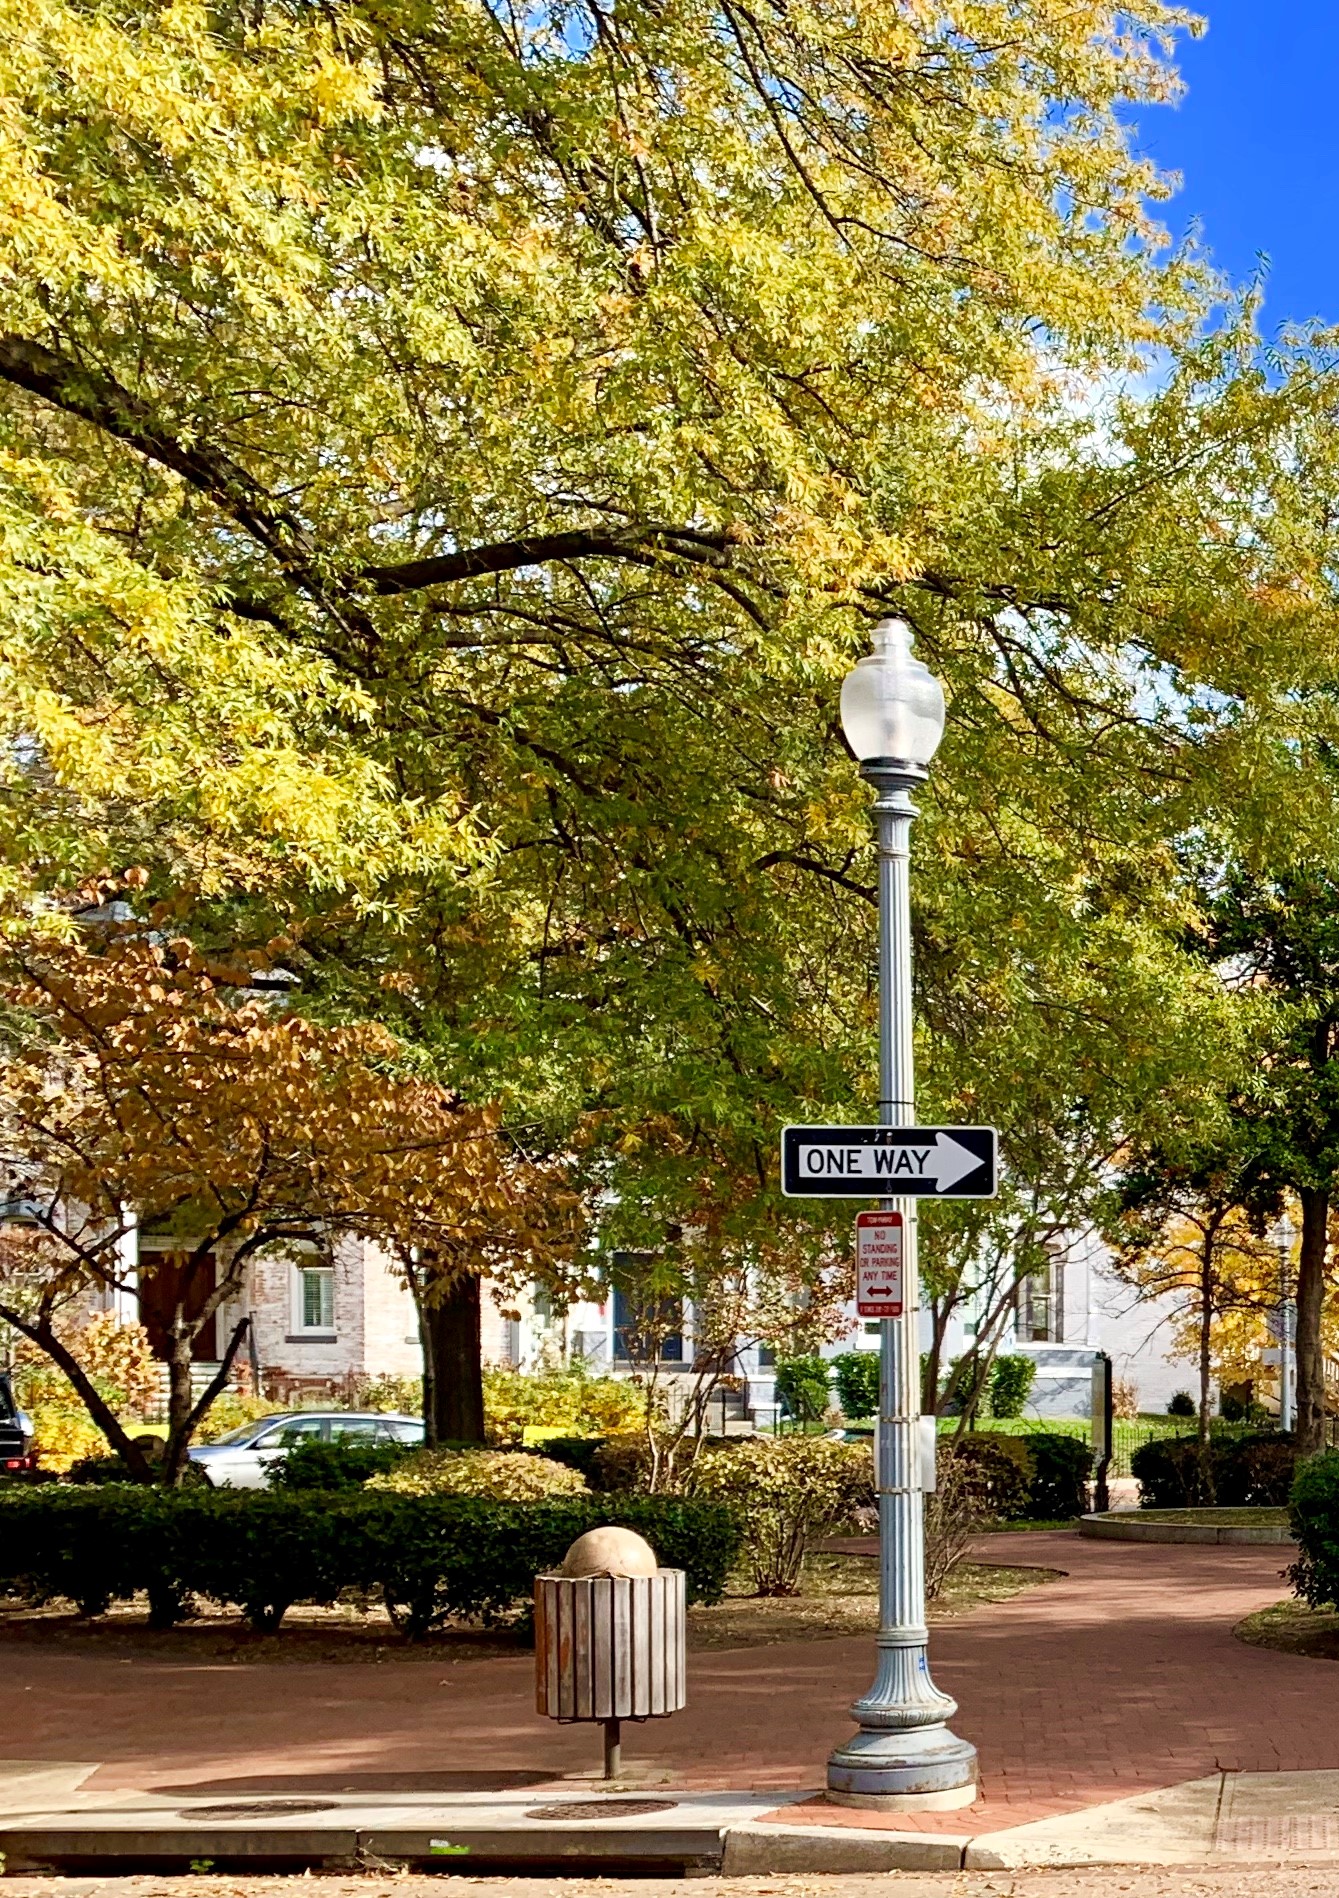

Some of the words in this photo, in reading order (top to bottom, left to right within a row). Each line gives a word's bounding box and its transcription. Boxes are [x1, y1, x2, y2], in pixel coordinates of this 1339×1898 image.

[807, 1149, 862, 1174] ONE
[873, 1149, 931, 1174] WAY
[874, 1230, 886, 1240] NO
[863, 1243, 898, 1254] STANDING
[872, 1257, 900, 1267] PARKING
[863, 1271, 878, 1281] ANY
[881, 1270, 897, 1280] TIME
